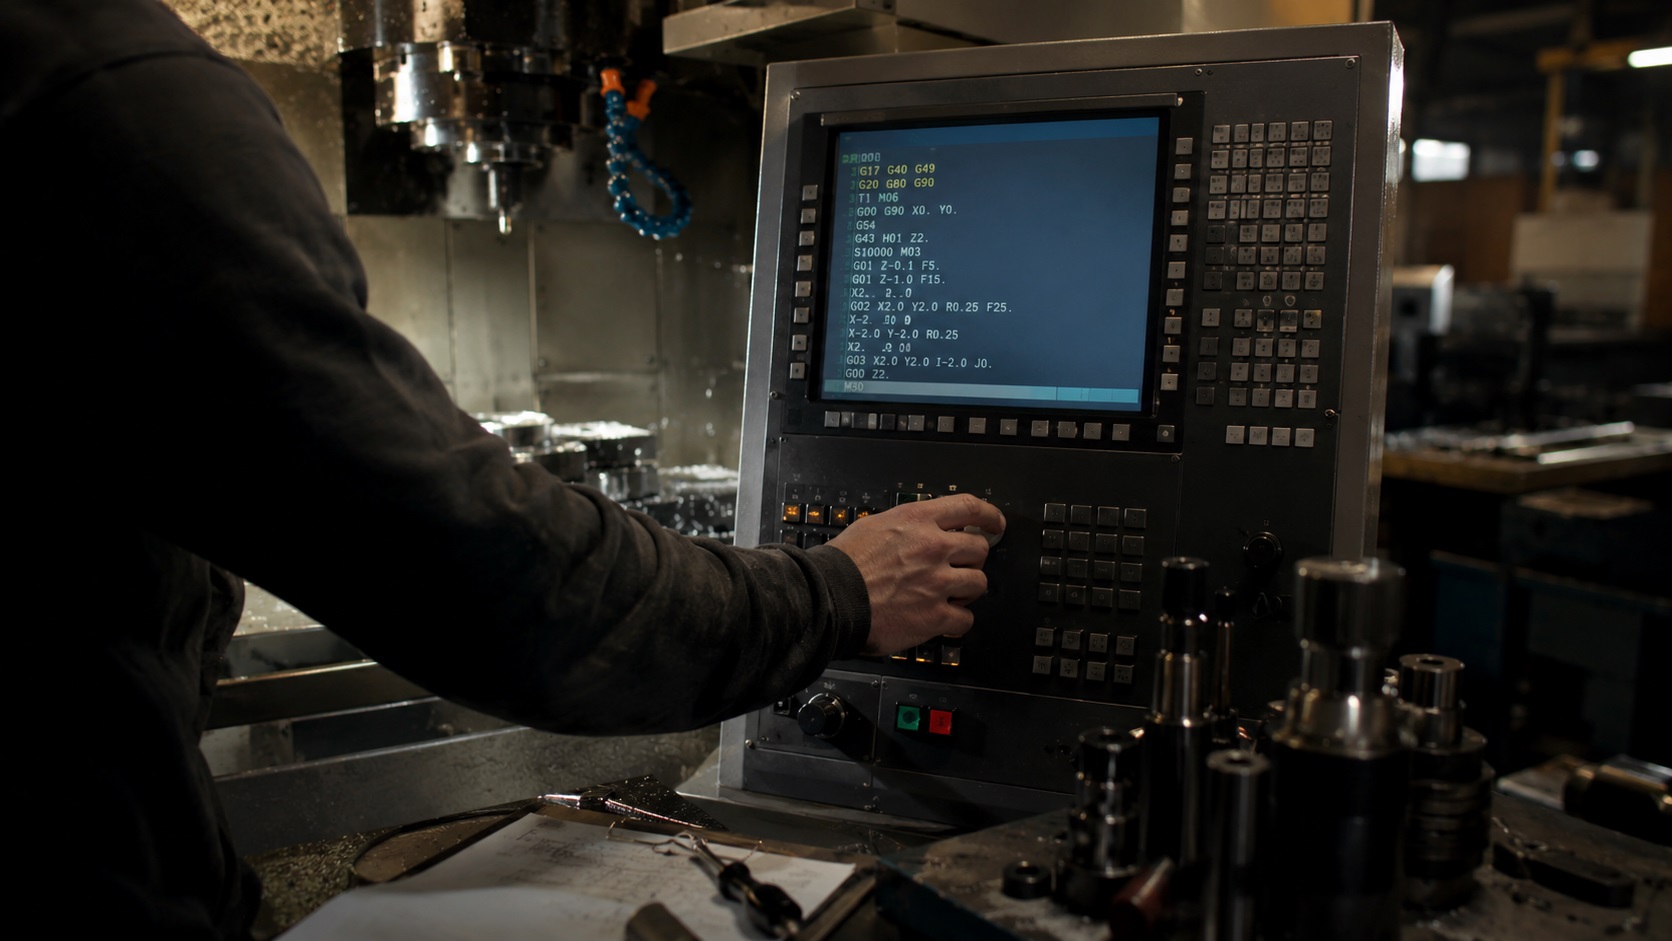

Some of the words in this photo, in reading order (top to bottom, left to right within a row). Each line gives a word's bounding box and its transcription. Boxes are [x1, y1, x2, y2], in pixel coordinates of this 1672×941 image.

[860, 166, 880, 176] G17
[888, 165, 907, 174] G40
[915, 164, 935, 173] G49
[859, 180, 878, 189] G20
[886, 179, 906, 188] G80
[914, 178, 934, 187] G90
[859, 194, 870, 203] T1
[878, 192, 898, 202] M06
[857, 207, 876, 216] G00
[884, 206, 904, 216] G90
[912, 206, 930, 215] X0.
[940, 205, 956, 214] Y0.
[856, 221, 875, 230] G54
[855, 234, 874, 243] G43
[883, 233, 901, 242] H01
[910, 233, 928, 242] Z2.
[854, 247, 893, 257] S10000
[901, 247, 920, 256] M03
[854, 261, 872, 270] G01
[881, 261, 912, 270] Z-0.1
[922, 261, 939, 270] F5.
[852, 275, 871, 284] G01
[880, 275, 912, 284] Z-1.0
[921, 274, 945, 284] F15.
[851, 301, 870, 311] G02
[878, 302, 904, 311] X2.0
[912, 302, 938, 311] Y2.0
[946, 302, 979, 312] R0.25
[987, 302, 1011, 312] F25.
[849, 329, 880, 338] X-2.0
[888, 329, 918, 338] Y-2.0
[926, 330, 958, 339] R0.25
[848, 342, 864, 351] X2.
[847, 356, 865, 365] G03
[873, 356, 898, 366] X2.0
[905, 357, 929, 366] Y2.0
[936, 358, 967, 367] I-2.0
[975, 359, 991, 368] J0.
[846, 369, 864, 378] G00
[872, 370, 889, 379] Z2.
[844, 381, 863, 392] M30
